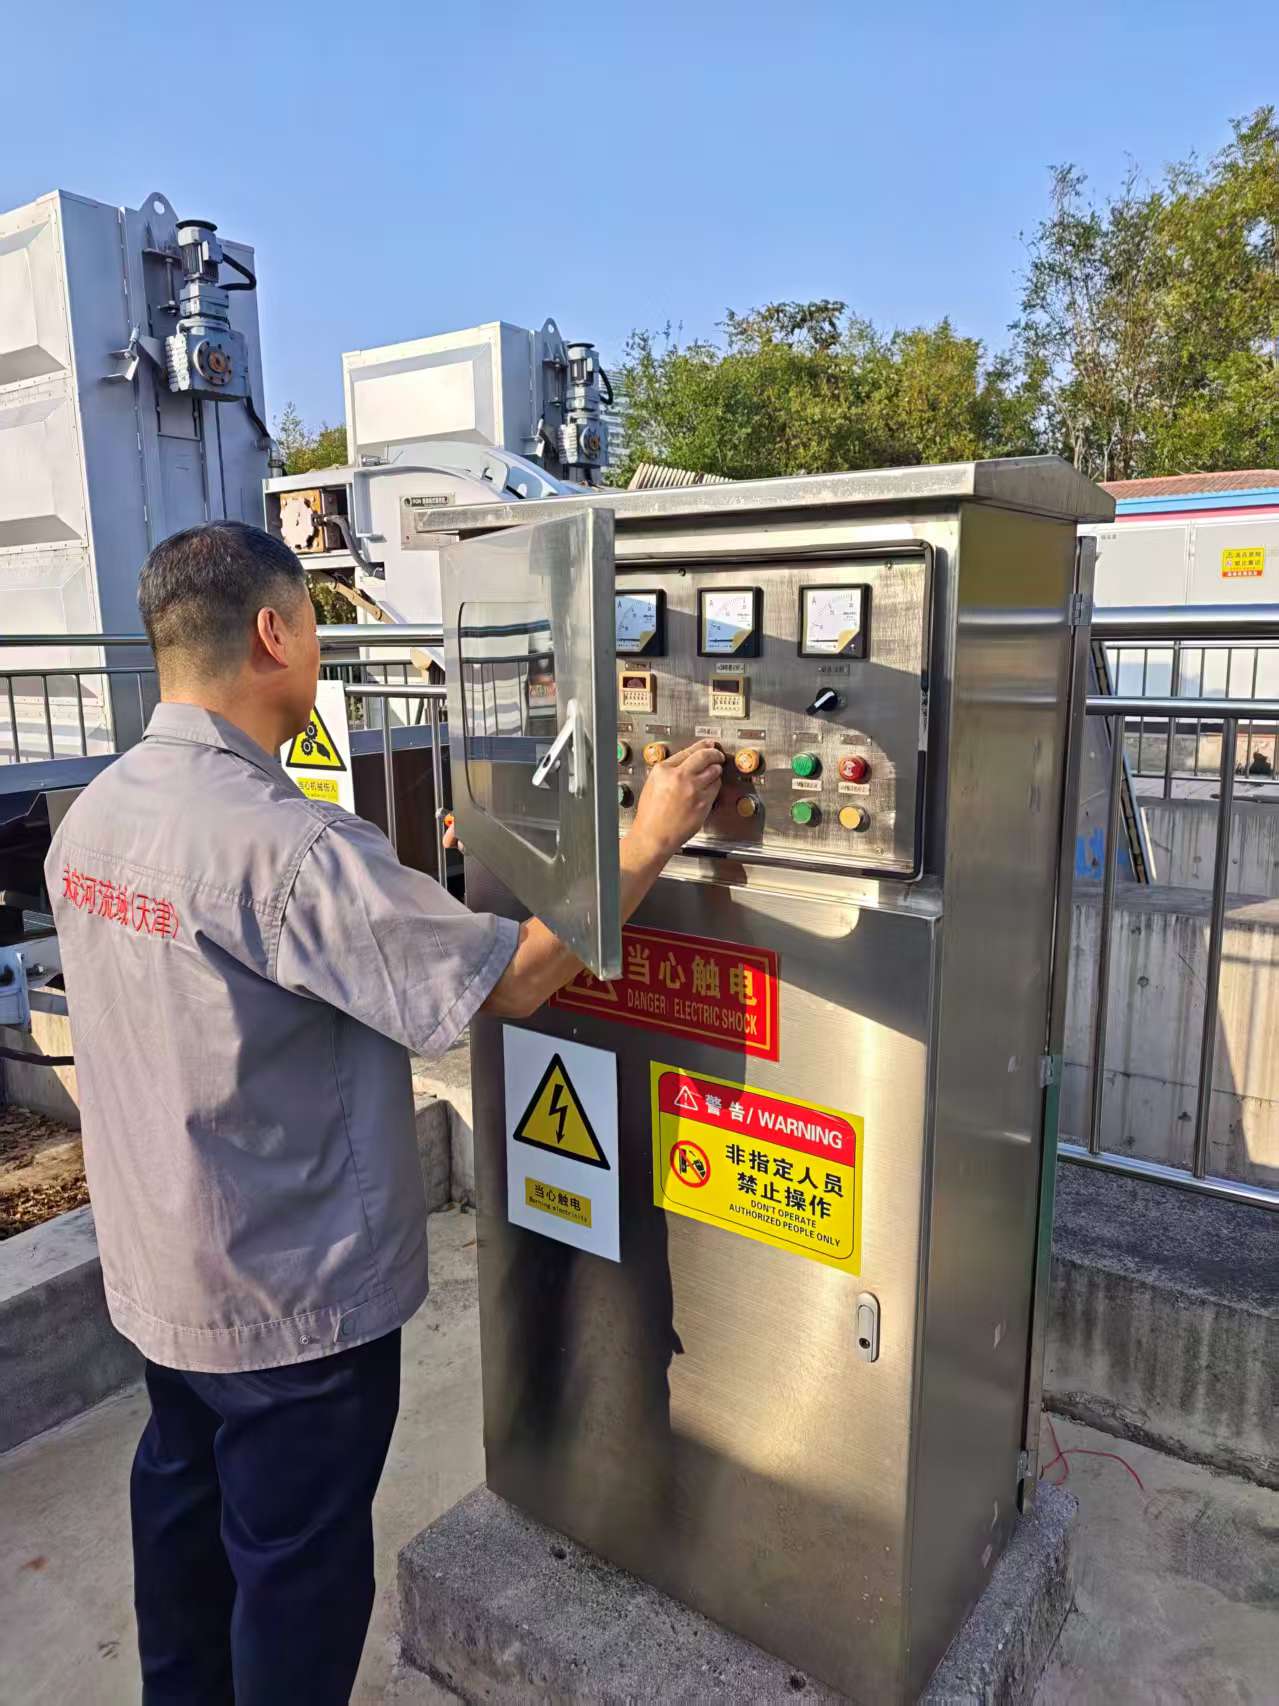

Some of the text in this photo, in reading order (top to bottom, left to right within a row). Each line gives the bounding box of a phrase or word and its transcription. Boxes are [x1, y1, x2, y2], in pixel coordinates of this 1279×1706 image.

[627, 943, 758, 1006] 当心触电
[627, 988, 758, 1036] DANGER ELECTRIC SHOCK
[758, 1109, 843, 1149] WARNING
[725, 1144, 844, 1199] 非指定人员
[534, 1183, 581, 1212] 当心触电
[737, 1172, 832, 1220] 禁止操作
[751, 1200, 817, 1229] DON'T OPERATE
[729, 1203, 841, 1248] AUTHORIZED PEOPLE ONLY
